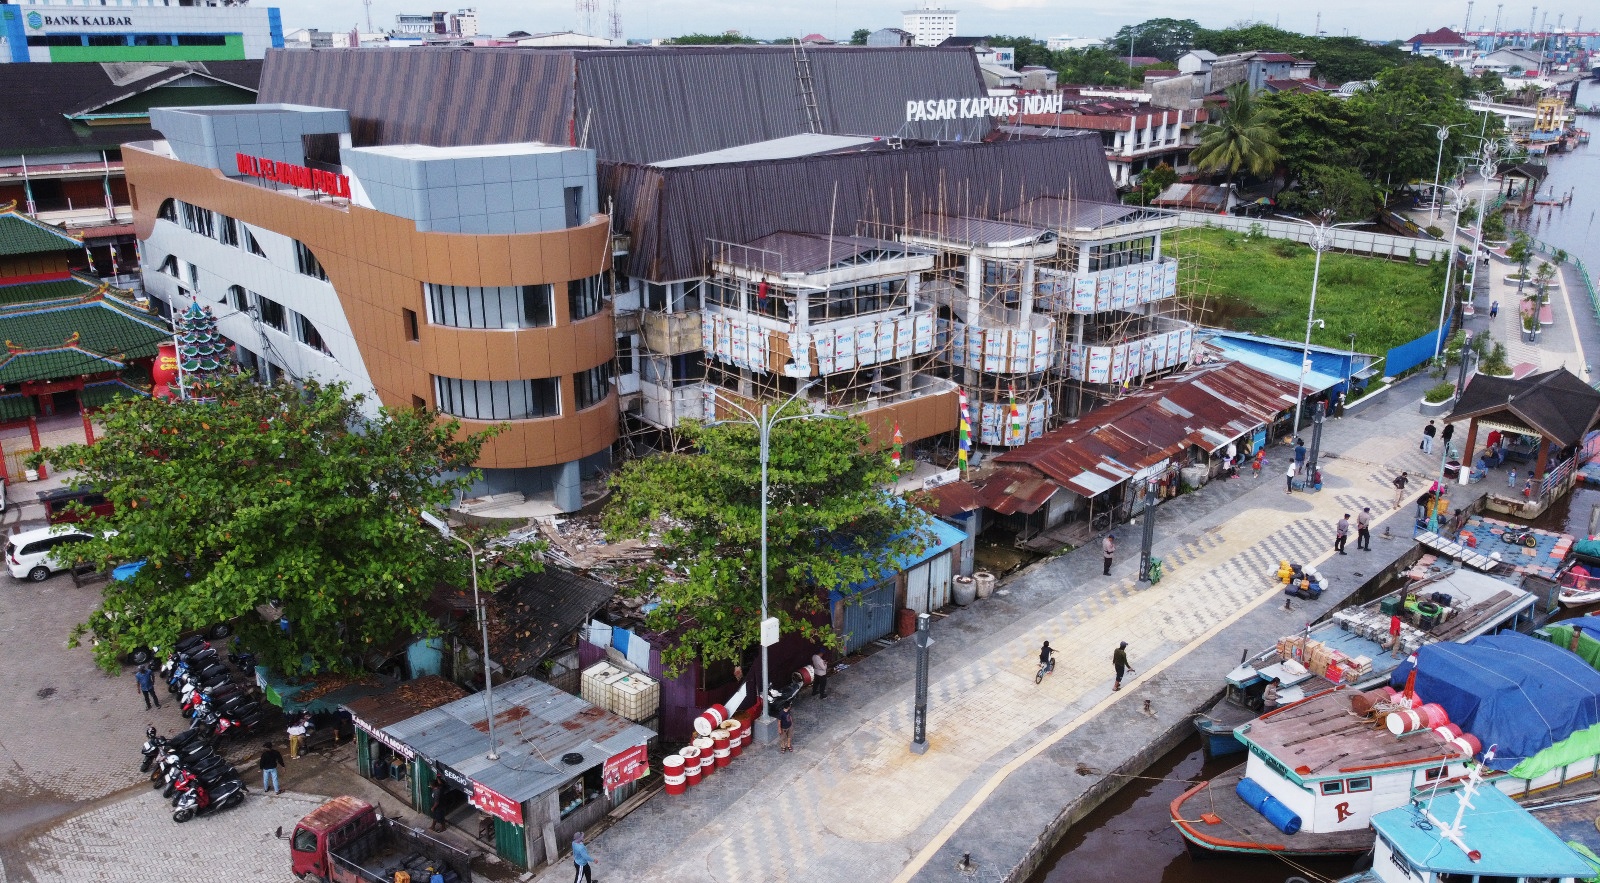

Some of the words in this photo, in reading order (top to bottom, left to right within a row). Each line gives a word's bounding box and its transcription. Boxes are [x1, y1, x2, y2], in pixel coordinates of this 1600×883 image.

[44, 16, 79, 25] BANK
[81, 16, 132, 25] KALBAR
[907, 99, 957, 121] PASAR
[960, 96, 1018, 119] KAPUAS
[1024, 94, 1063, 115] NDAH
[258, 157, 313, 190] PELAYANAN
[312, 168, 352, 199] PUBLIK
[371, 727, 389, 743] JAYA
[389, 738, 413, 758] MOTOR
[444, 769, 467, 786] SERGIO
[1335, 802, 1356, 823] R
